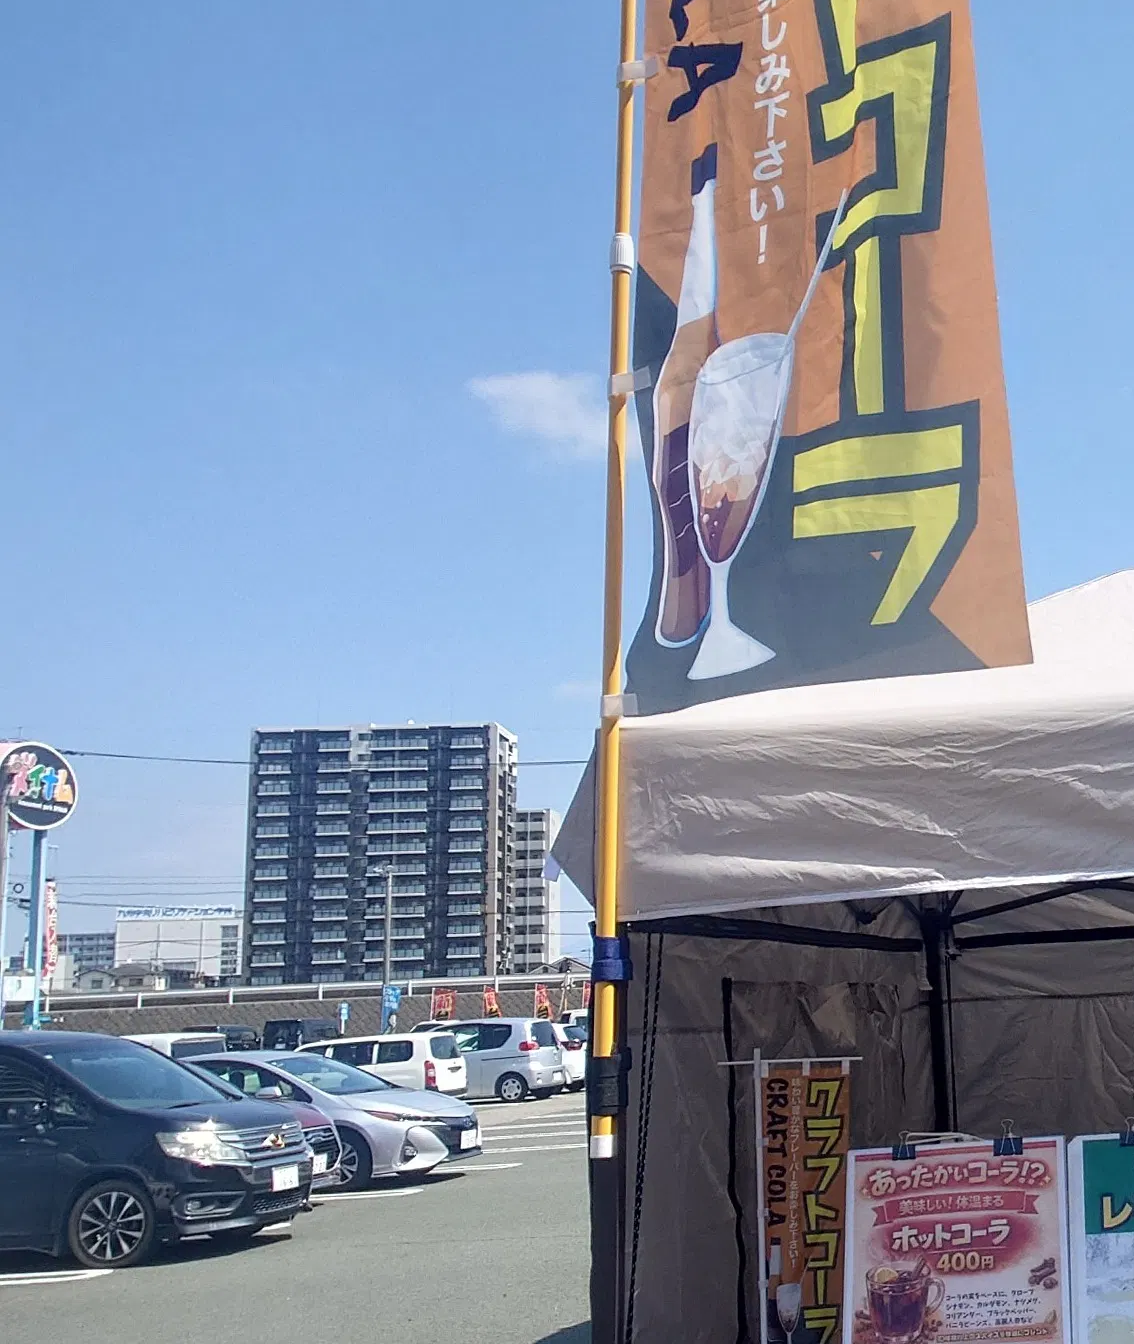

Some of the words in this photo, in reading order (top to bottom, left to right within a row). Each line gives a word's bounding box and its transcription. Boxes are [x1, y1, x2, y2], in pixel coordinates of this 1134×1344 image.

[766, 1076, 789, 1158] CRAFT
[766, 1163, 787, 1228] COLA
[869, 1160, 1046, 1197] あったかいコーラ!?
[891, 1218, 1011, 1252] ホットコーラ
[936, 1251, 994, 1273] 400円
